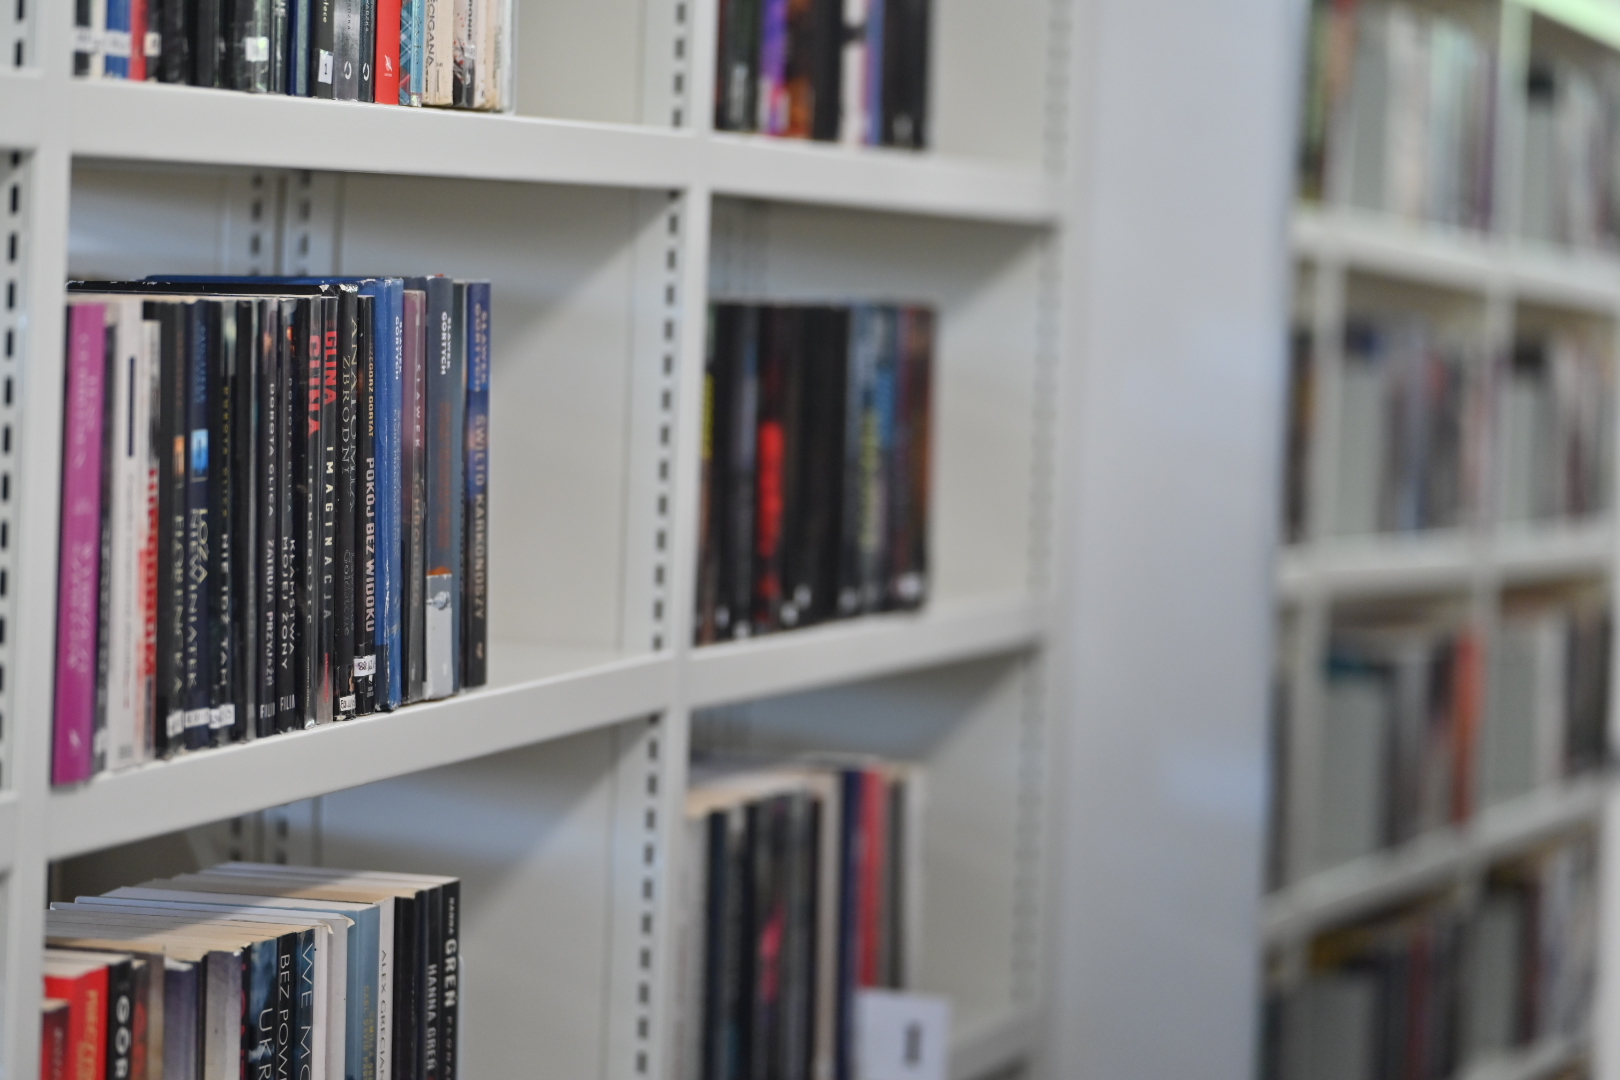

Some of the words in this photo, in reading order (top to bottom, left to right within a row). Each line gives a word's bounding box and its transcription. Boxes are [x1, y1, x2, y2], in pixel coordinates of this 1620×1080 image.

[440, 311, 448, 376] GORTYCH
[268, 382, 276, 457] DOROTA
[341, 355, 351, 478] ZBRODNI
[365, 457, 377, 518] POKÓJ
[220, 532, 229, 574] NIE
[323, 445, 335, 619] IMAGINACJA
[365, 522, 376, 556] BEZ
[281, 535, 290, 602] MOJEJ
[365, 559, 376, 633] WIDOKU
[219, 637, 229, 687] TAM
[280, 611, 290, 671] ŻONY
[279, 954, 291, 1002] BEZ
[300, 943, 314, 1009] WE
[380, 949, 388, 995] ALEX
[427, 963, 438, 1022] HANNA
[444, 938, 459, 1008] GREŃ
[278, 1009, 289, 1080] POW
[426, 1027, 438, 1071] GREŃ
